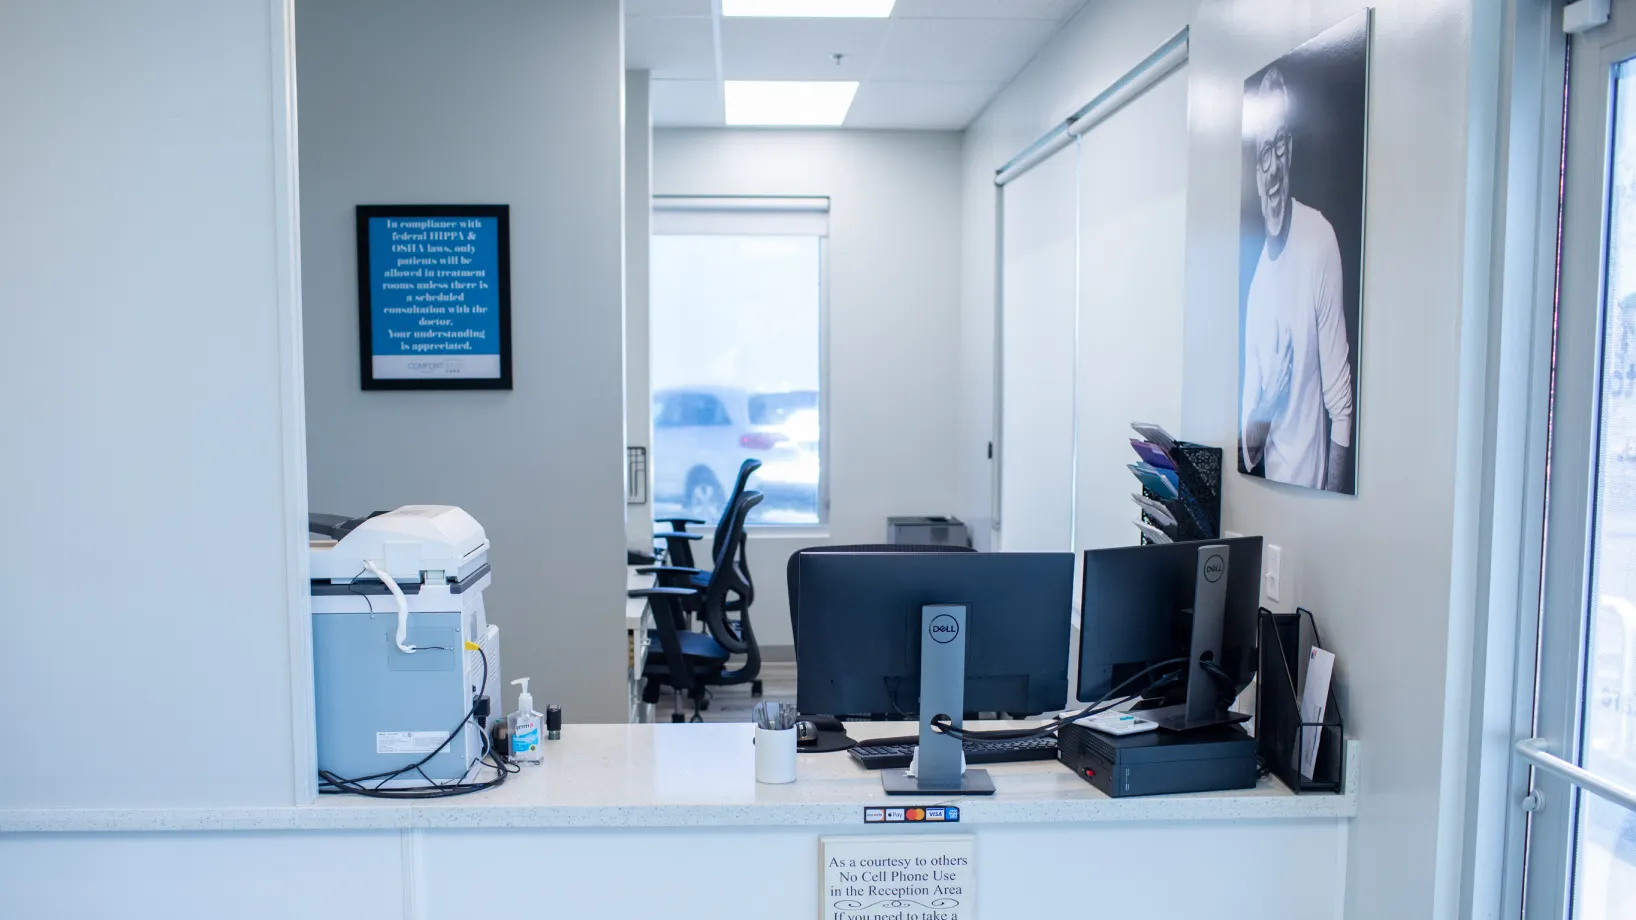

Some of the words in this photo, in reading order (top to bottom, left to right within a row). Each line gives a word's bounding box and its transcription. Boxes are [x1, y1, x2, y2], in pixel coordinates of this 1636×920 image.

[387, 219, 398, 228] In
[400, 219, 457, 230] compliance
[459, 219, 482, 228] with
[392, 231, 427, 240] federal
[430, 231, 464, 240] HIPPA
[466, 231, 477, 240] &
[392, 243, 424, 252] OSHA
[454, 243, 476, 254] only
[397, 256, 438, 267] patients
[439, 256, 459, 265] will
[460, 256, 472, 265] be
[384, 268, 422, 277] allowed
[424, 268, 435, 277] in
[437, 269, 485, 277] treatment
[417, 281, 448, 289] unless
[451, 281, 477, 289] there
[479, 281, 488, 289] is
[415, 293, 464, 301] scheduled
[384, 305, 445, 313] consultation
[448, 305, 469, 313] with
[472, 305, 488, 313] the
[419, 317, 453, 325] doctor.
[388, 329, 411, 338] Your
[414, 329, 485, 339] understanding
[401, 342, 410, 350] is
[412, 342, 472, 352] appreciated.
[1206, 564, 1222, 573] DELL
[932, 625, 956, 633] DELL
[892, 811, 903, 819] Pay
[829, 857, 846, 868] As
[860, 857, 911, 869] courtesy
[915, 858, 927, 867] to
[930, 854, 968, 866] others
[839, 871, 858, 882] No
[861, 871, 887, 882] Cell
[891, 871, 929, 882] Phone
[933, 870, 957, 881] Use
[830, 886, 842, 897] in
[846, 886, 864, 896] the
[868, 885, 929, 898] Reception
[933, 884, 962, 895] Area
[922, 911, 950, 920] take
